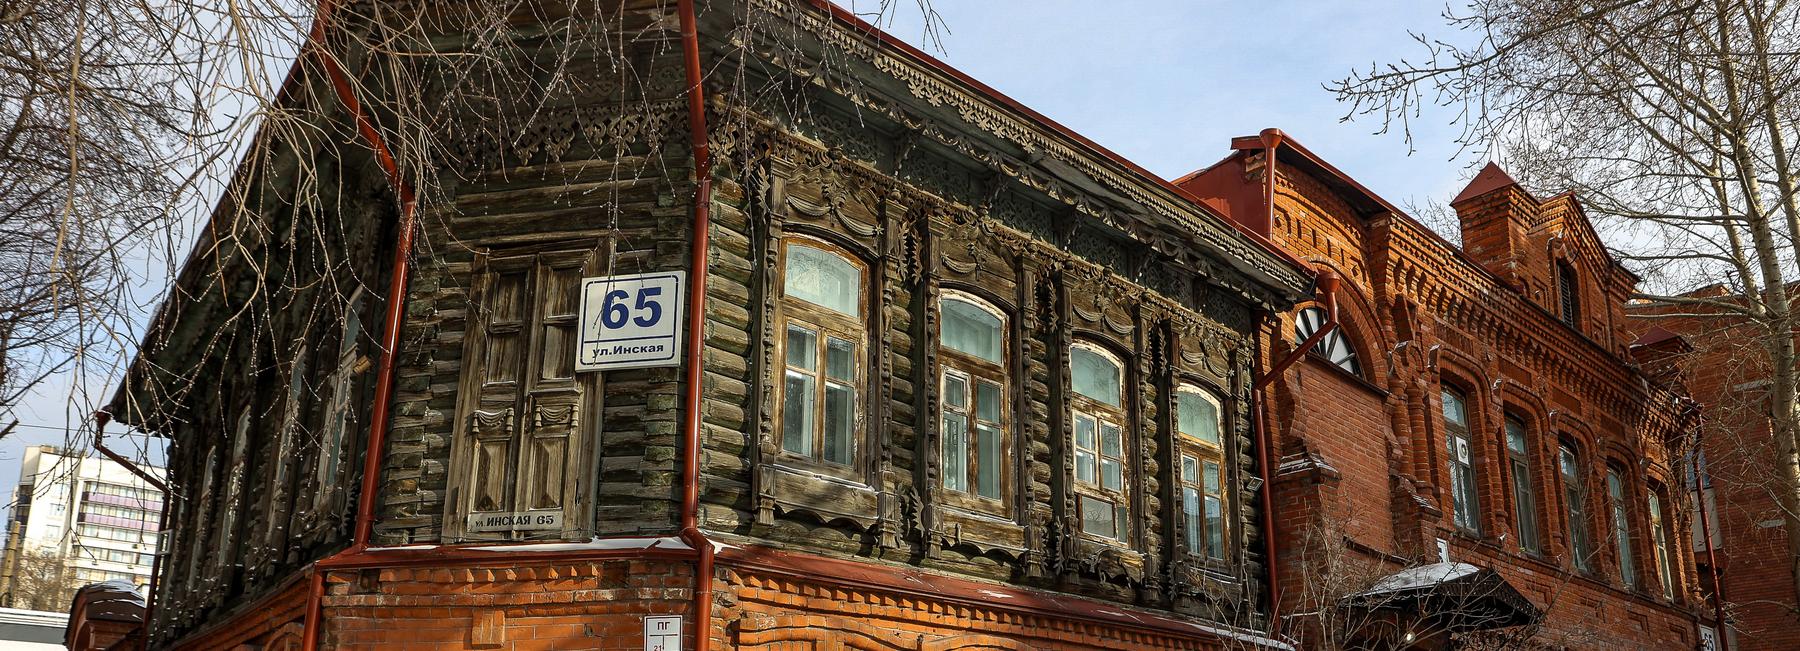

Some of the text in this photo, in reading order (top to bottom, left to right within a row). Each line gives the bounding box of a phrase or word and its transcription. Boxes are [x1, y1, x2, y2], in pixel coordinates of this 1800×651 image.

[602, 287, 662, 329] 65
[487, 515, 531, 527] ИНСКАЯ
[536, 515, 554, 525] 65
[657, 622, 671, 630] ПГ
